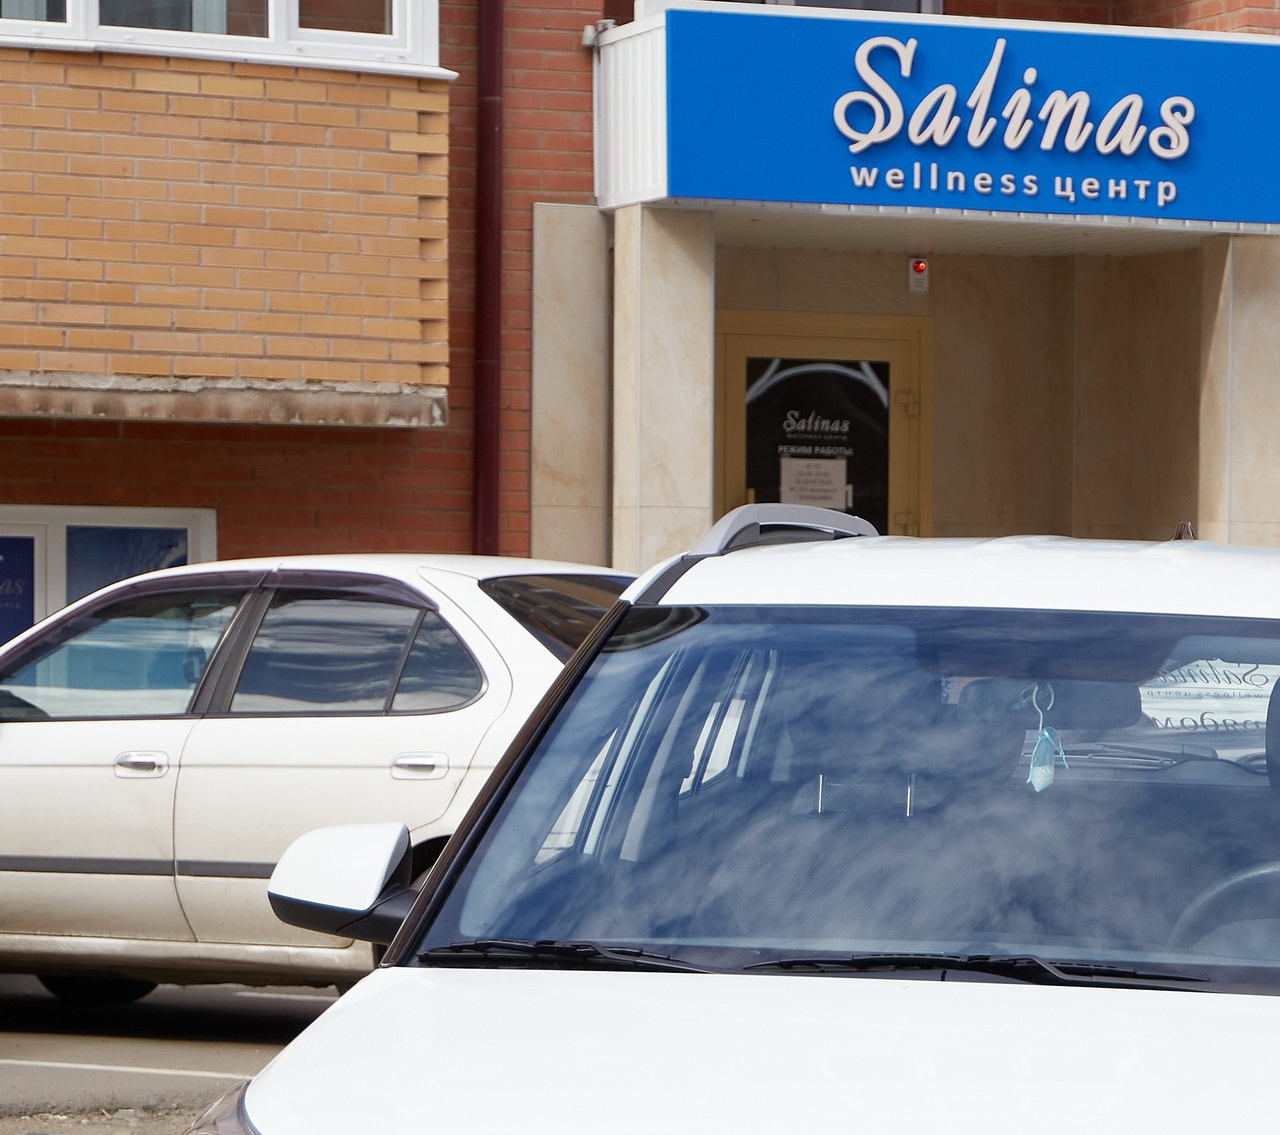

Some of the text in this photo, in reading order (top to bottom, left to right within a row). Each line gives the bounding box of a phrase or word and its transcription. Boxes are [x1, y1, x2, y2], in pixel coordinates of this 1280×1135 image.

[832, 35, 1196, 160] Salinas
[849, 161, 1178, 206] wellness центр
[783, 410, 851, 433] Salinas
